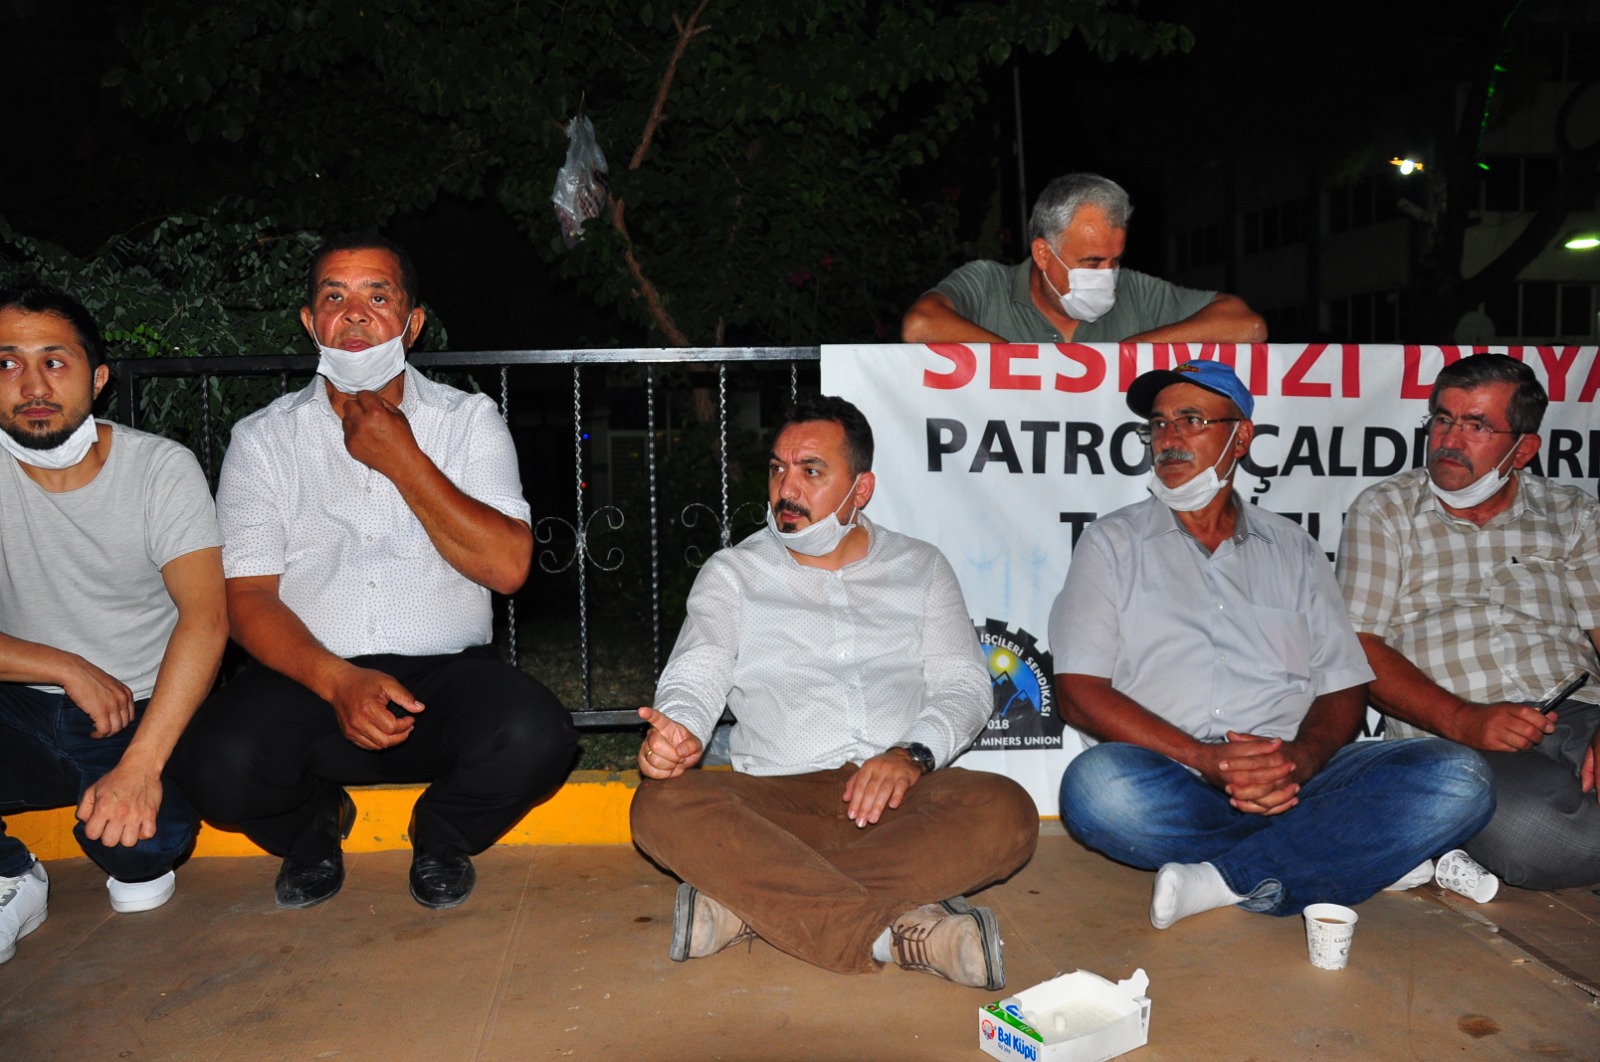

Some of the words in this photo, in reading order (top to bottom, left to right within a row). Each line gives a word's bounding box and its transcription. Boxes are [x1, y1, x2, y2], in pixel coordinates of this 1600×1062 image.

[926, 417, 1151, 476] PATRO
[1025, 656, 1052, 718] SENDİKASI
[981, 735, 1022, 747] MINERS
[1024, 734, 1062, 746] UNION
[986, 718, 1010, 731] 018
[997, 1026, 1012, 1047] Bal
[1012, 1034, 1037, 1062] Küpü
